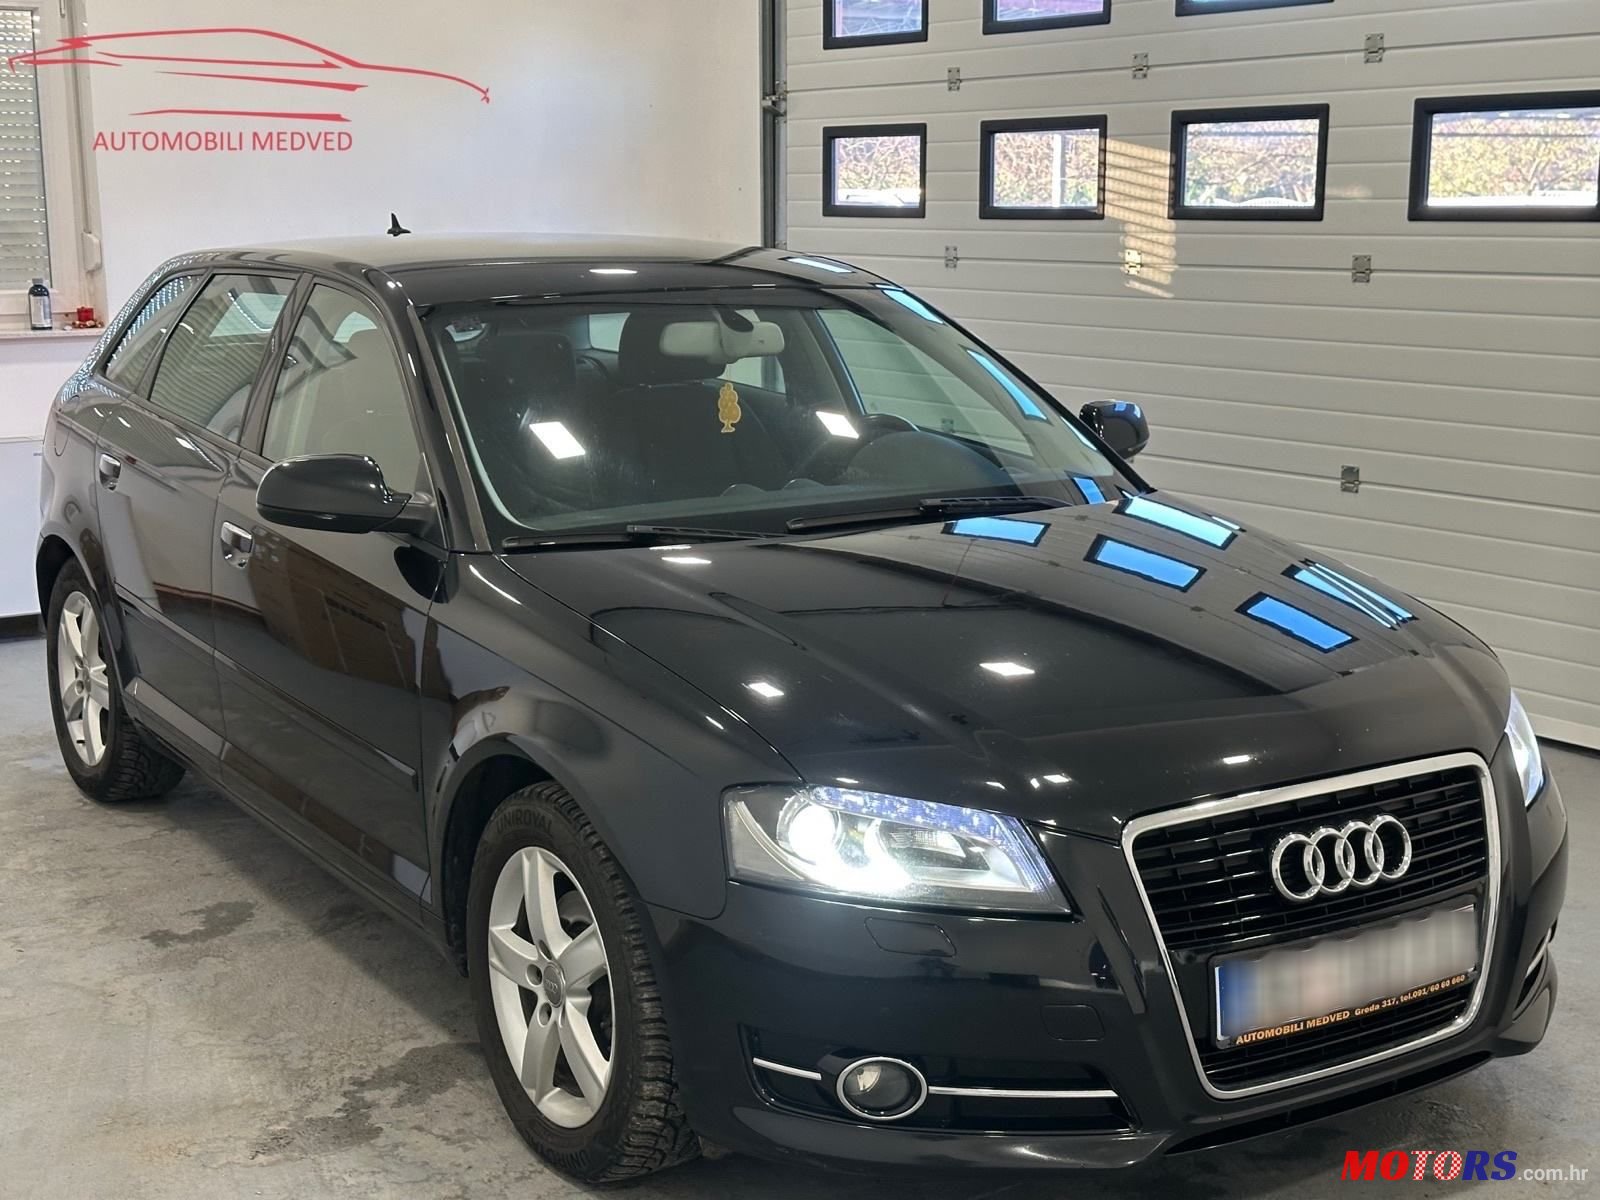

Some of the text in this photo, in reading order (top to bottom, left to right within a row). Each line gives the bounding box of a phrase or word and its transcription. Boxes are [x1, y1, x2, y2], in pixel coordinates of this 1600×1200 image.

[93, 131, 353, 151] AUTOMOBILI MEDVED
[496, 808, 552, 833] UNIROYAL
[1235, 1022, 1304, 1045] AUTOMOBILI
[1306, 1010, 1350, 1029] MEDVED
[1381, 997, 1399, 1008] 317,
